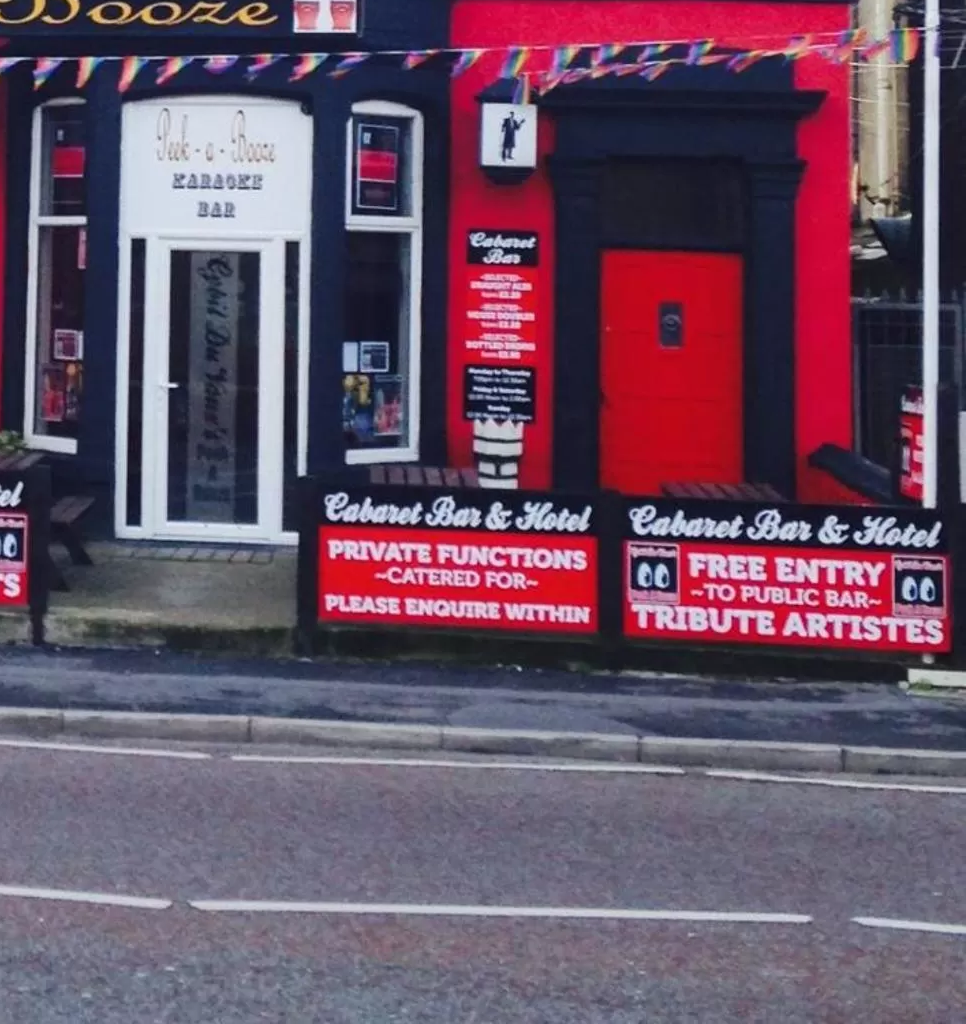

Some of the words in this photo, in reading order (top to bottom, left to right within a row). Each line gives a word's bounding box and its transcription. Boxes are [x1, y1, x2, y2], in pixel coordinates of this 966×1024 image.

[172, 173, 263, 190] KARAOKE
[197, 201, 236, 218] BAR
[469, 231, 537, 249] Cabaret
[483, 249, 521, 265] Bar
[324, 492, 423, 526] Cabaret
[425, 495, 482, 528] Bar
[485, 501, 513, 531] &
[516, 501, 593, 532] Hotel
[629, 504, 744, 539] Cabaret
[746, 508, 813, 542] Bar
[817, 515, 850, 545] &
[853, 515, 943, 548] Hotel
[327, 540, 432, 563] PRIVATE
[436, 544, 588, 570] FUNCTIONS
[688, 553, 767, 581] FREE
[774, 556, 886, 587] ENTRY
[324, 594, 401, 615] PLEASE
[404, 597, 500, 619] ENQUIRE
[502, 601, 591, 624] WITHIN
[741, 587, 819, 606] PUBLIC
[631, 604, 776, 636] TRIBUTE
[782, 611, 944, 645] ARTISTES
